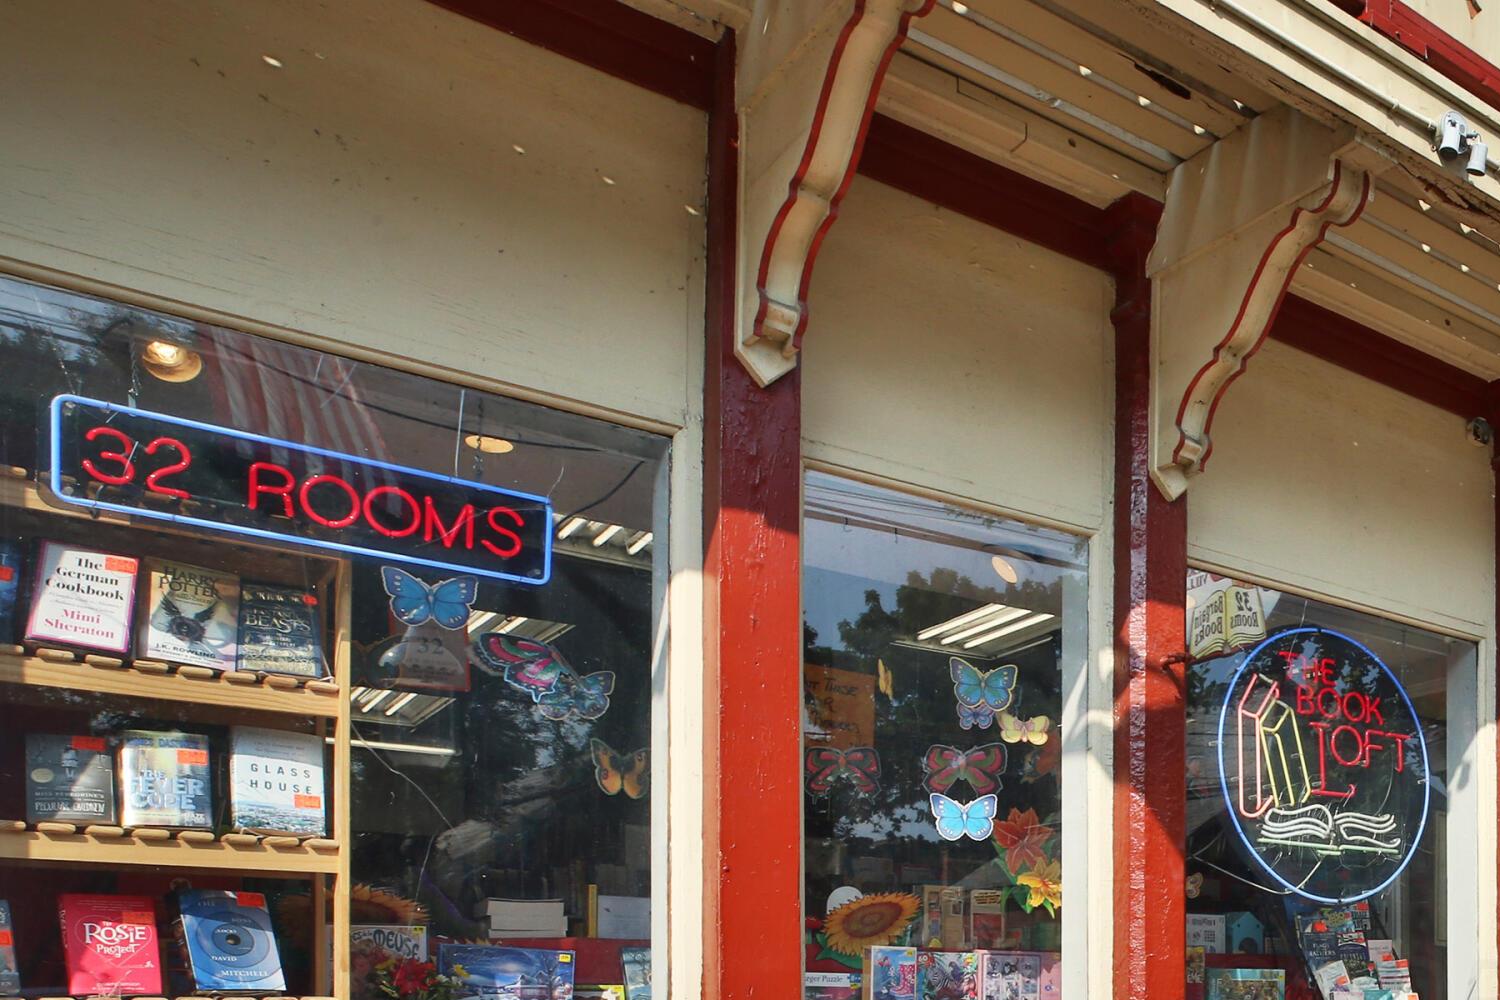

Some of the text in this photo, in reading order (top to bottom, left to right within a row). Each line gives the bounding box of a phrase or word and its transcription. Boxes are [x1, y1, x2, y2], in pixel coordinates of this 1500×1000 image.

[82, 427, 525, 558] 32 ROOMS
[76, 557, 102, 571] The
[56, 567, 119, 586] German
[163, 566, 218, 586] HARRY
[45, 578, 124, 601] Cookbook
[159, 576, 222, 599] POTTER
[62, 609, 101, 624] Mimi
[44, 618, 114, 639] Sheraton
[1278, 651, 1336, 687] THE
[1296, 685, 1384, 726] BOOK
[250, 763, 311, 779] GLASS
[1308, 722, 1411, 798] LOFT
[250, 780, 312, 794] HOUSE
[373, 929, 420, 959] MEUSE
